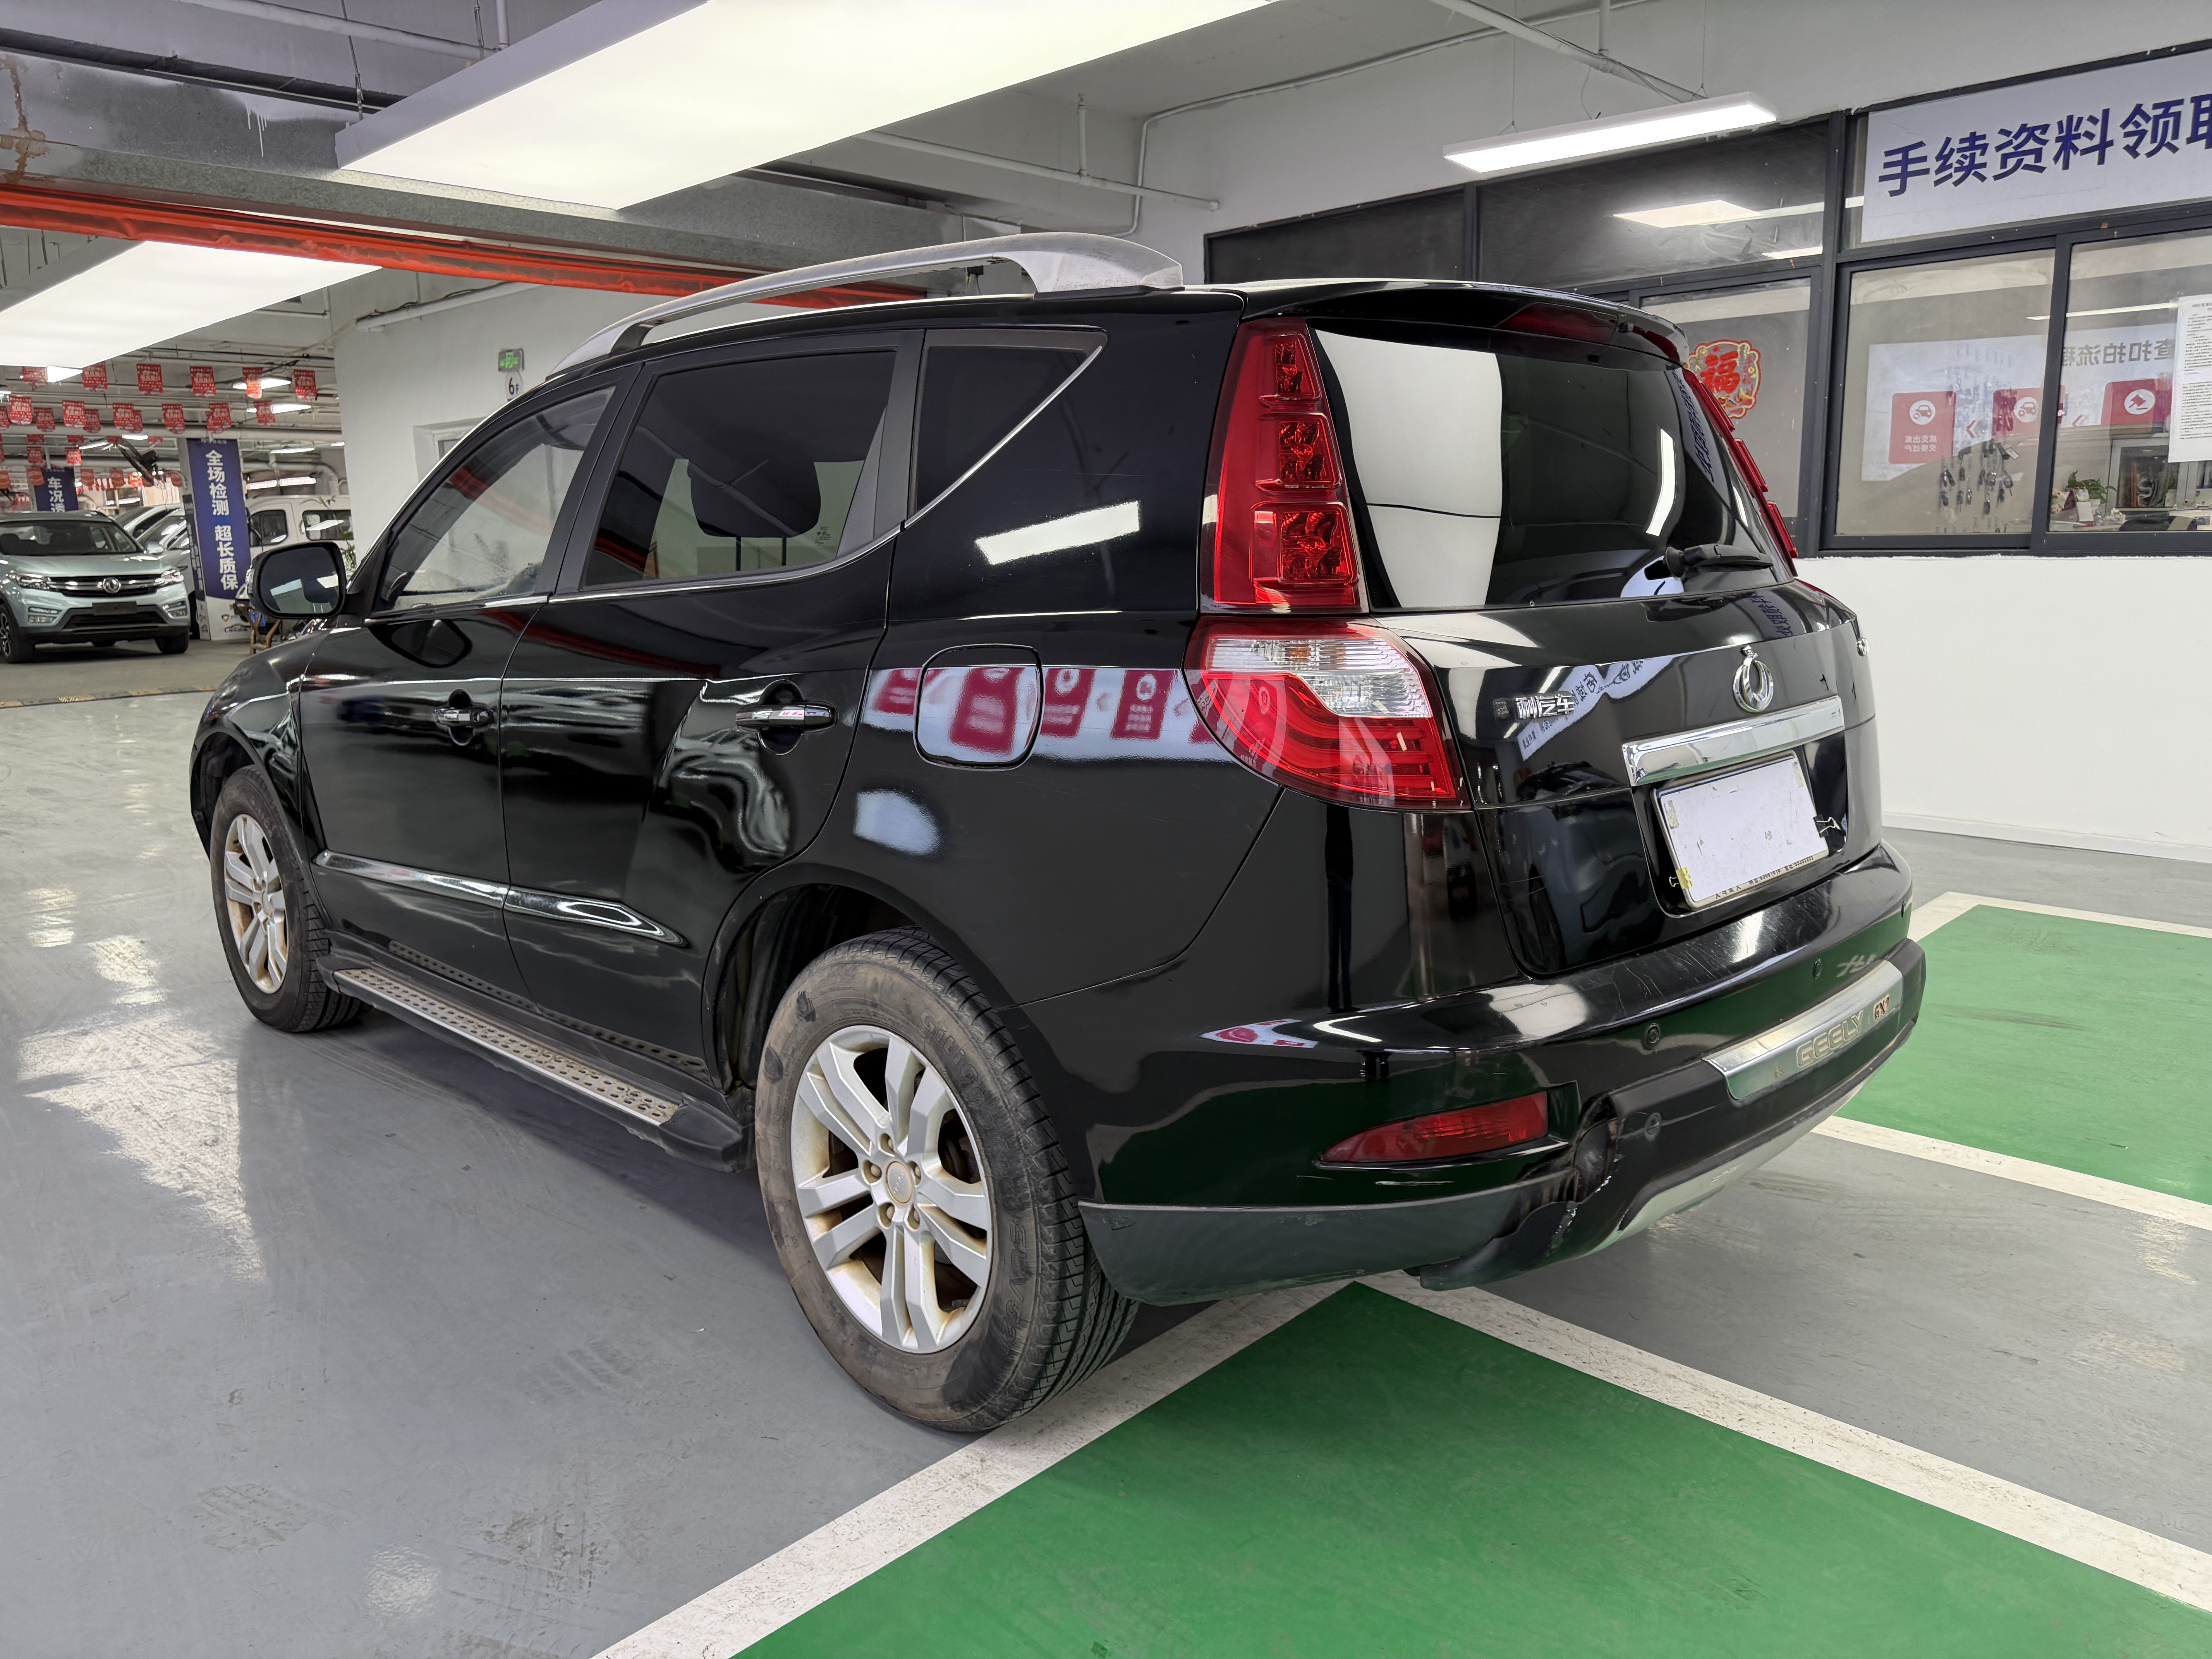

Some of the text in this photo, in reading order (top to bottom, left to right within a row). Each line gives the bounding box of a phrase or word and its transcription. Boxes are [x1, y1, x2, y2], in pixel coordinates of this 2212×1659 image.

[206, 449, 229, 516] 全场检测
[215, 525, 238, 591] 超长质保
[1796, 1010, 1863, 1067] GEELY
